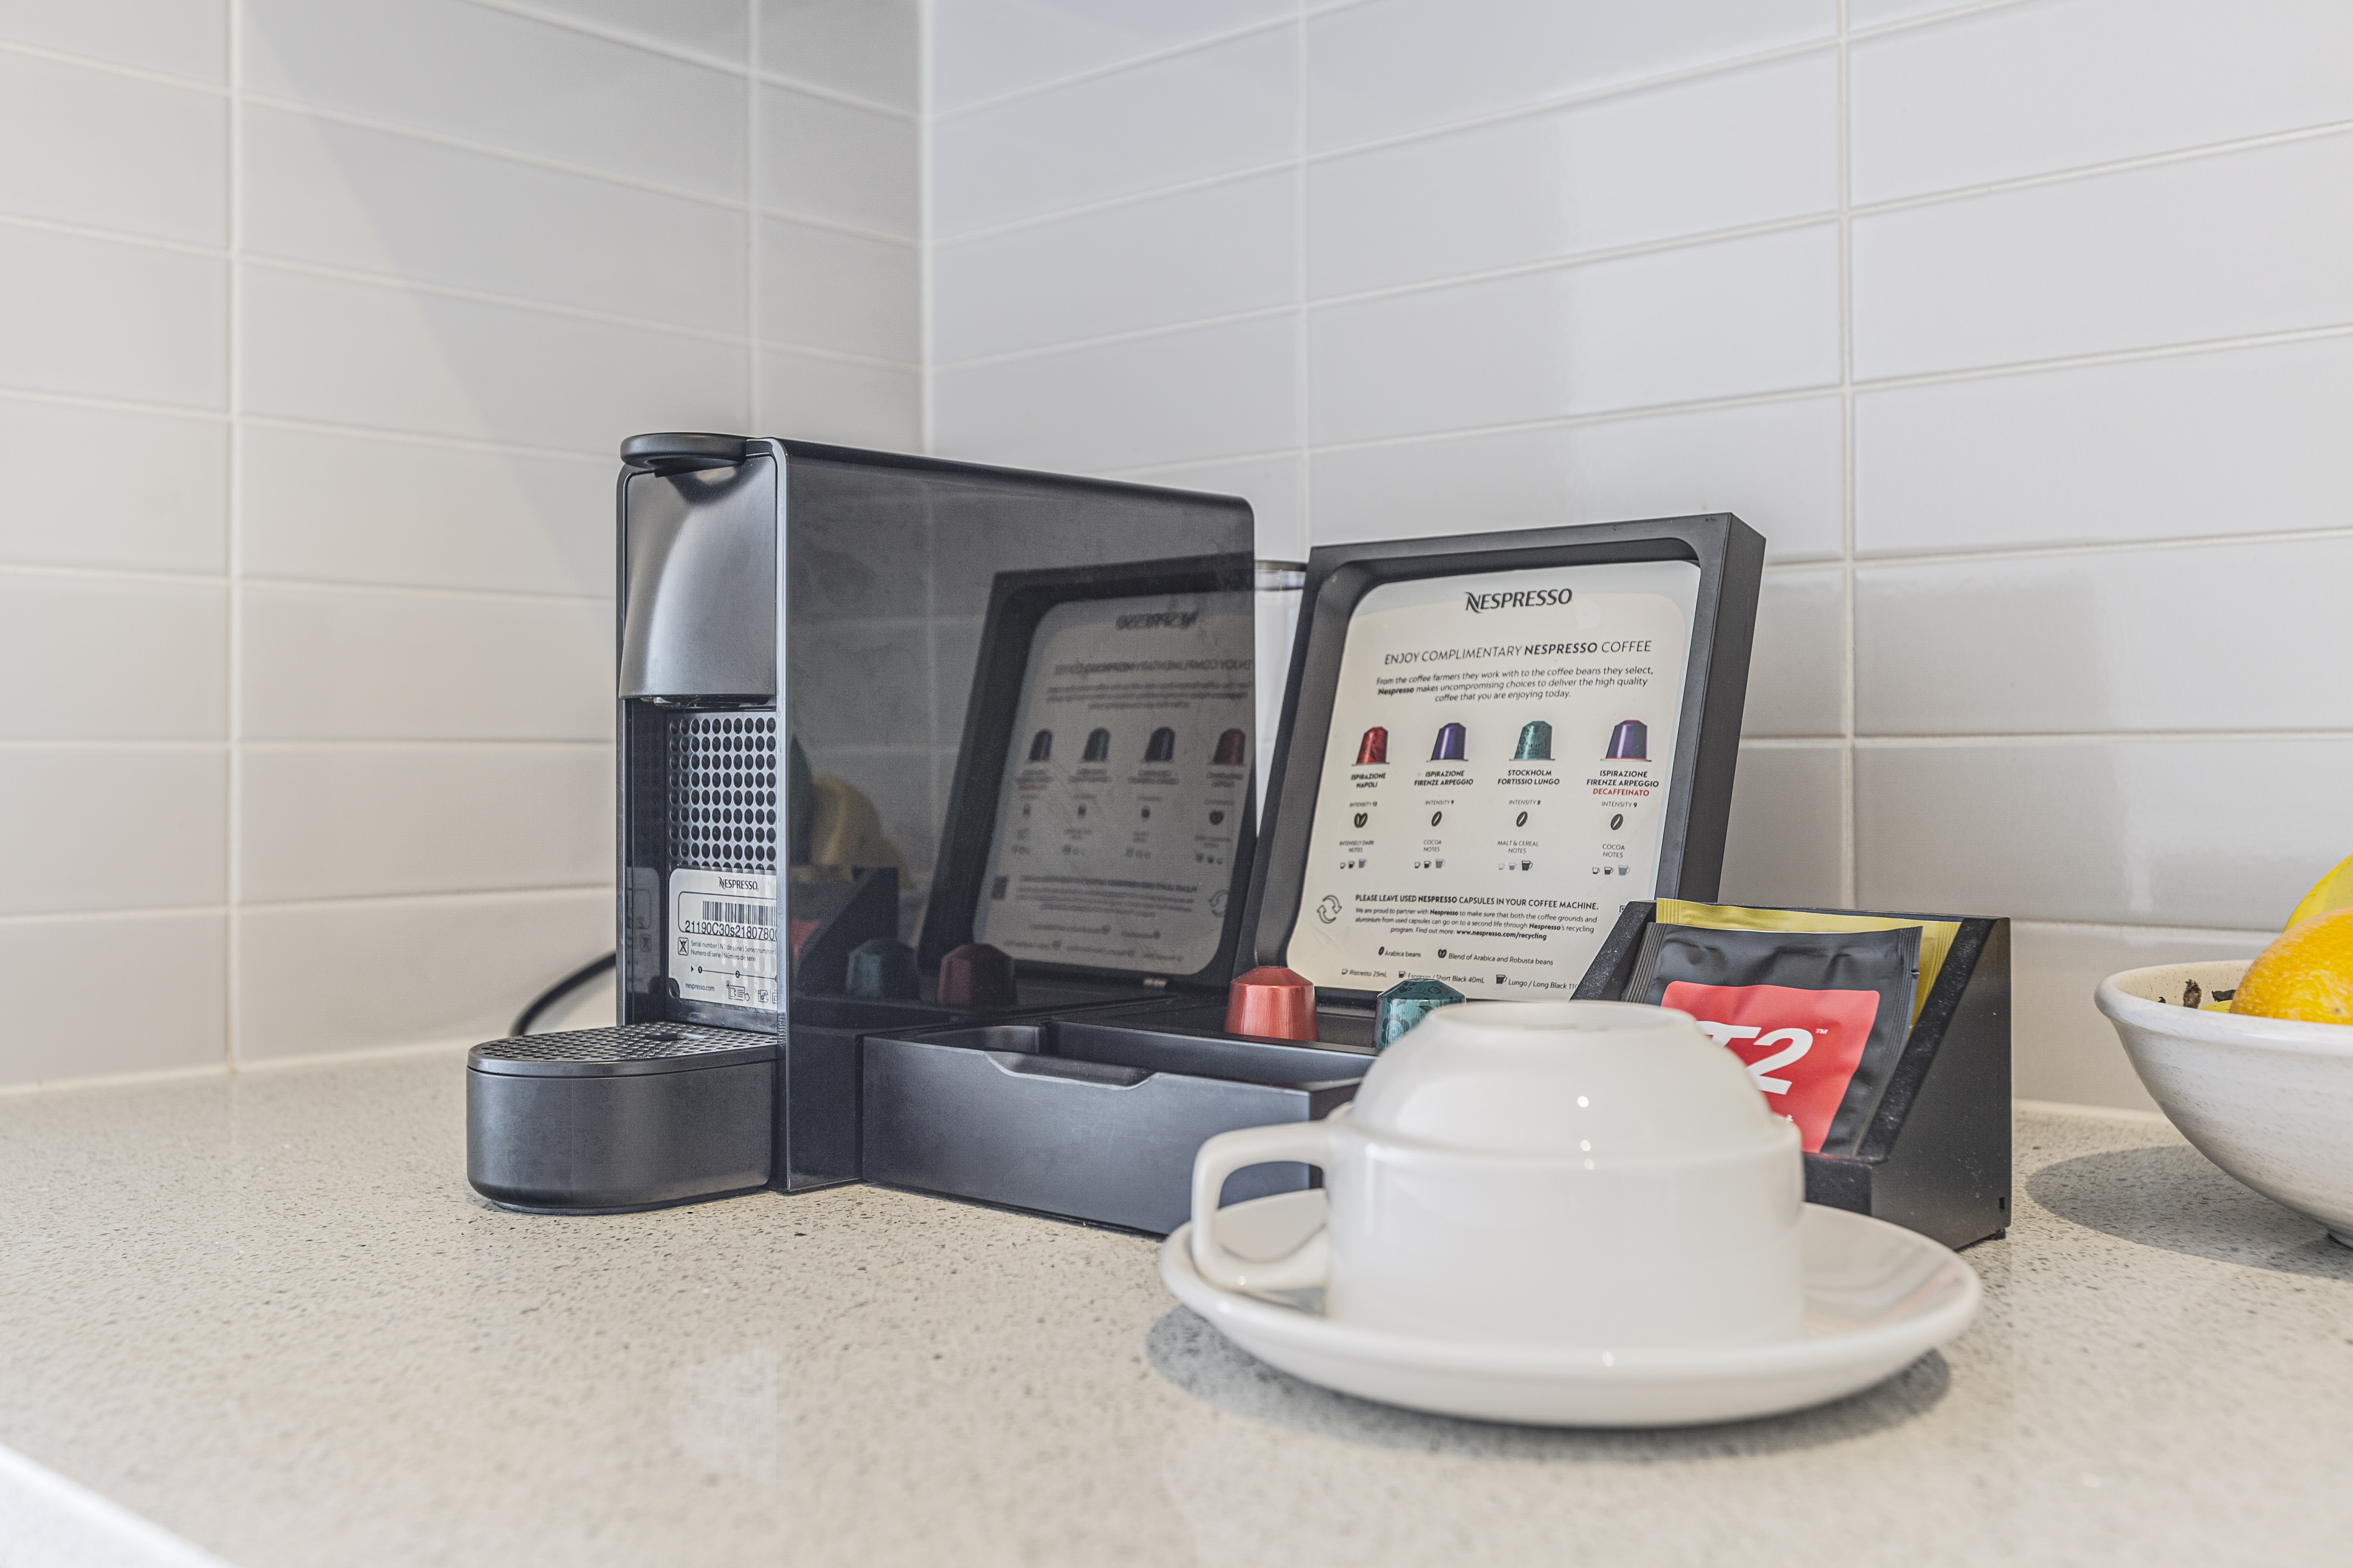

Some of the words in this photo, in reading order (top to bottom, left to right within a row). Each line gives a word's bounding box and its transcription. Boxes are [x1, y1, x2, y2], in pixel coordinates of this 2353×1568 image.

[1464, 588, 1573, 613] NESPRESSO
[1384, 652, 1420, 665] ENJOY
[1421, 646, 1522, 662] COMPLIMENTARY
[1524, 642, 1598, 655] NESPRESSO
[1601, 640, 1652, 653] COFFEE
[1376, 677, 1394, 686] From
[1408, 674, 1431, 683] coffee
[1462, 672, 1479, 681] they
[1481, 670, 1499, 678] work
[1547, 667, 1574, 676] coffee
[1604, 666, 1623, 676] they
[1625, 666, 1653, 675] select,
[1377, 687, 1415, 697] Nespresso
[1440, 682, 1504, 691] uncompromising
[1548, 678, 1577, 686] deliver
[1579, 678, 1593, 686] the
[1595, 677, 1615, 688] high
[1617, 677, 1648, 687] quality
[1435, 693, 1458, 702] coffee
[1460, 692, 1476, 701] that
[1478, 693, 1492, 702] you
[1508, 691, 1543, 701] enjoying
[1546, 689, 1571, 699] today.
[1593, 788, 1650, 796] DECAFFEINATO
[718, 877, 758, 890] NESPRESSO
[1418, 895, 1458, 903] NESPRESSO
[1459, 896, 1494, 905] CAPSULES
[1528, 899, 1557, 908] COFFEE
[1559, 901, 1599, 910] MACHINE.
[1429, 909, 1459, 917] Nespresso
[1504, 921, 1528, 930] through
[1529, 923, 1565, 931] Nespresso's
[1566, 925, 1594, 934] recycling
[1456, 930, 1547, 941] www.nespresso.com/recycling
[745, 946, 774, 954] Seriennummer
[1509, 956, 1534, 964] Robusta
[685, 983, 715, 992] nespresso.com
[1509, 979, 1528, 987] Lungo
[1533, 981, 1549, 989] Long
[1550, 981, 1567, 989] Black
[1695, 1021, 1813, 1095] T2
